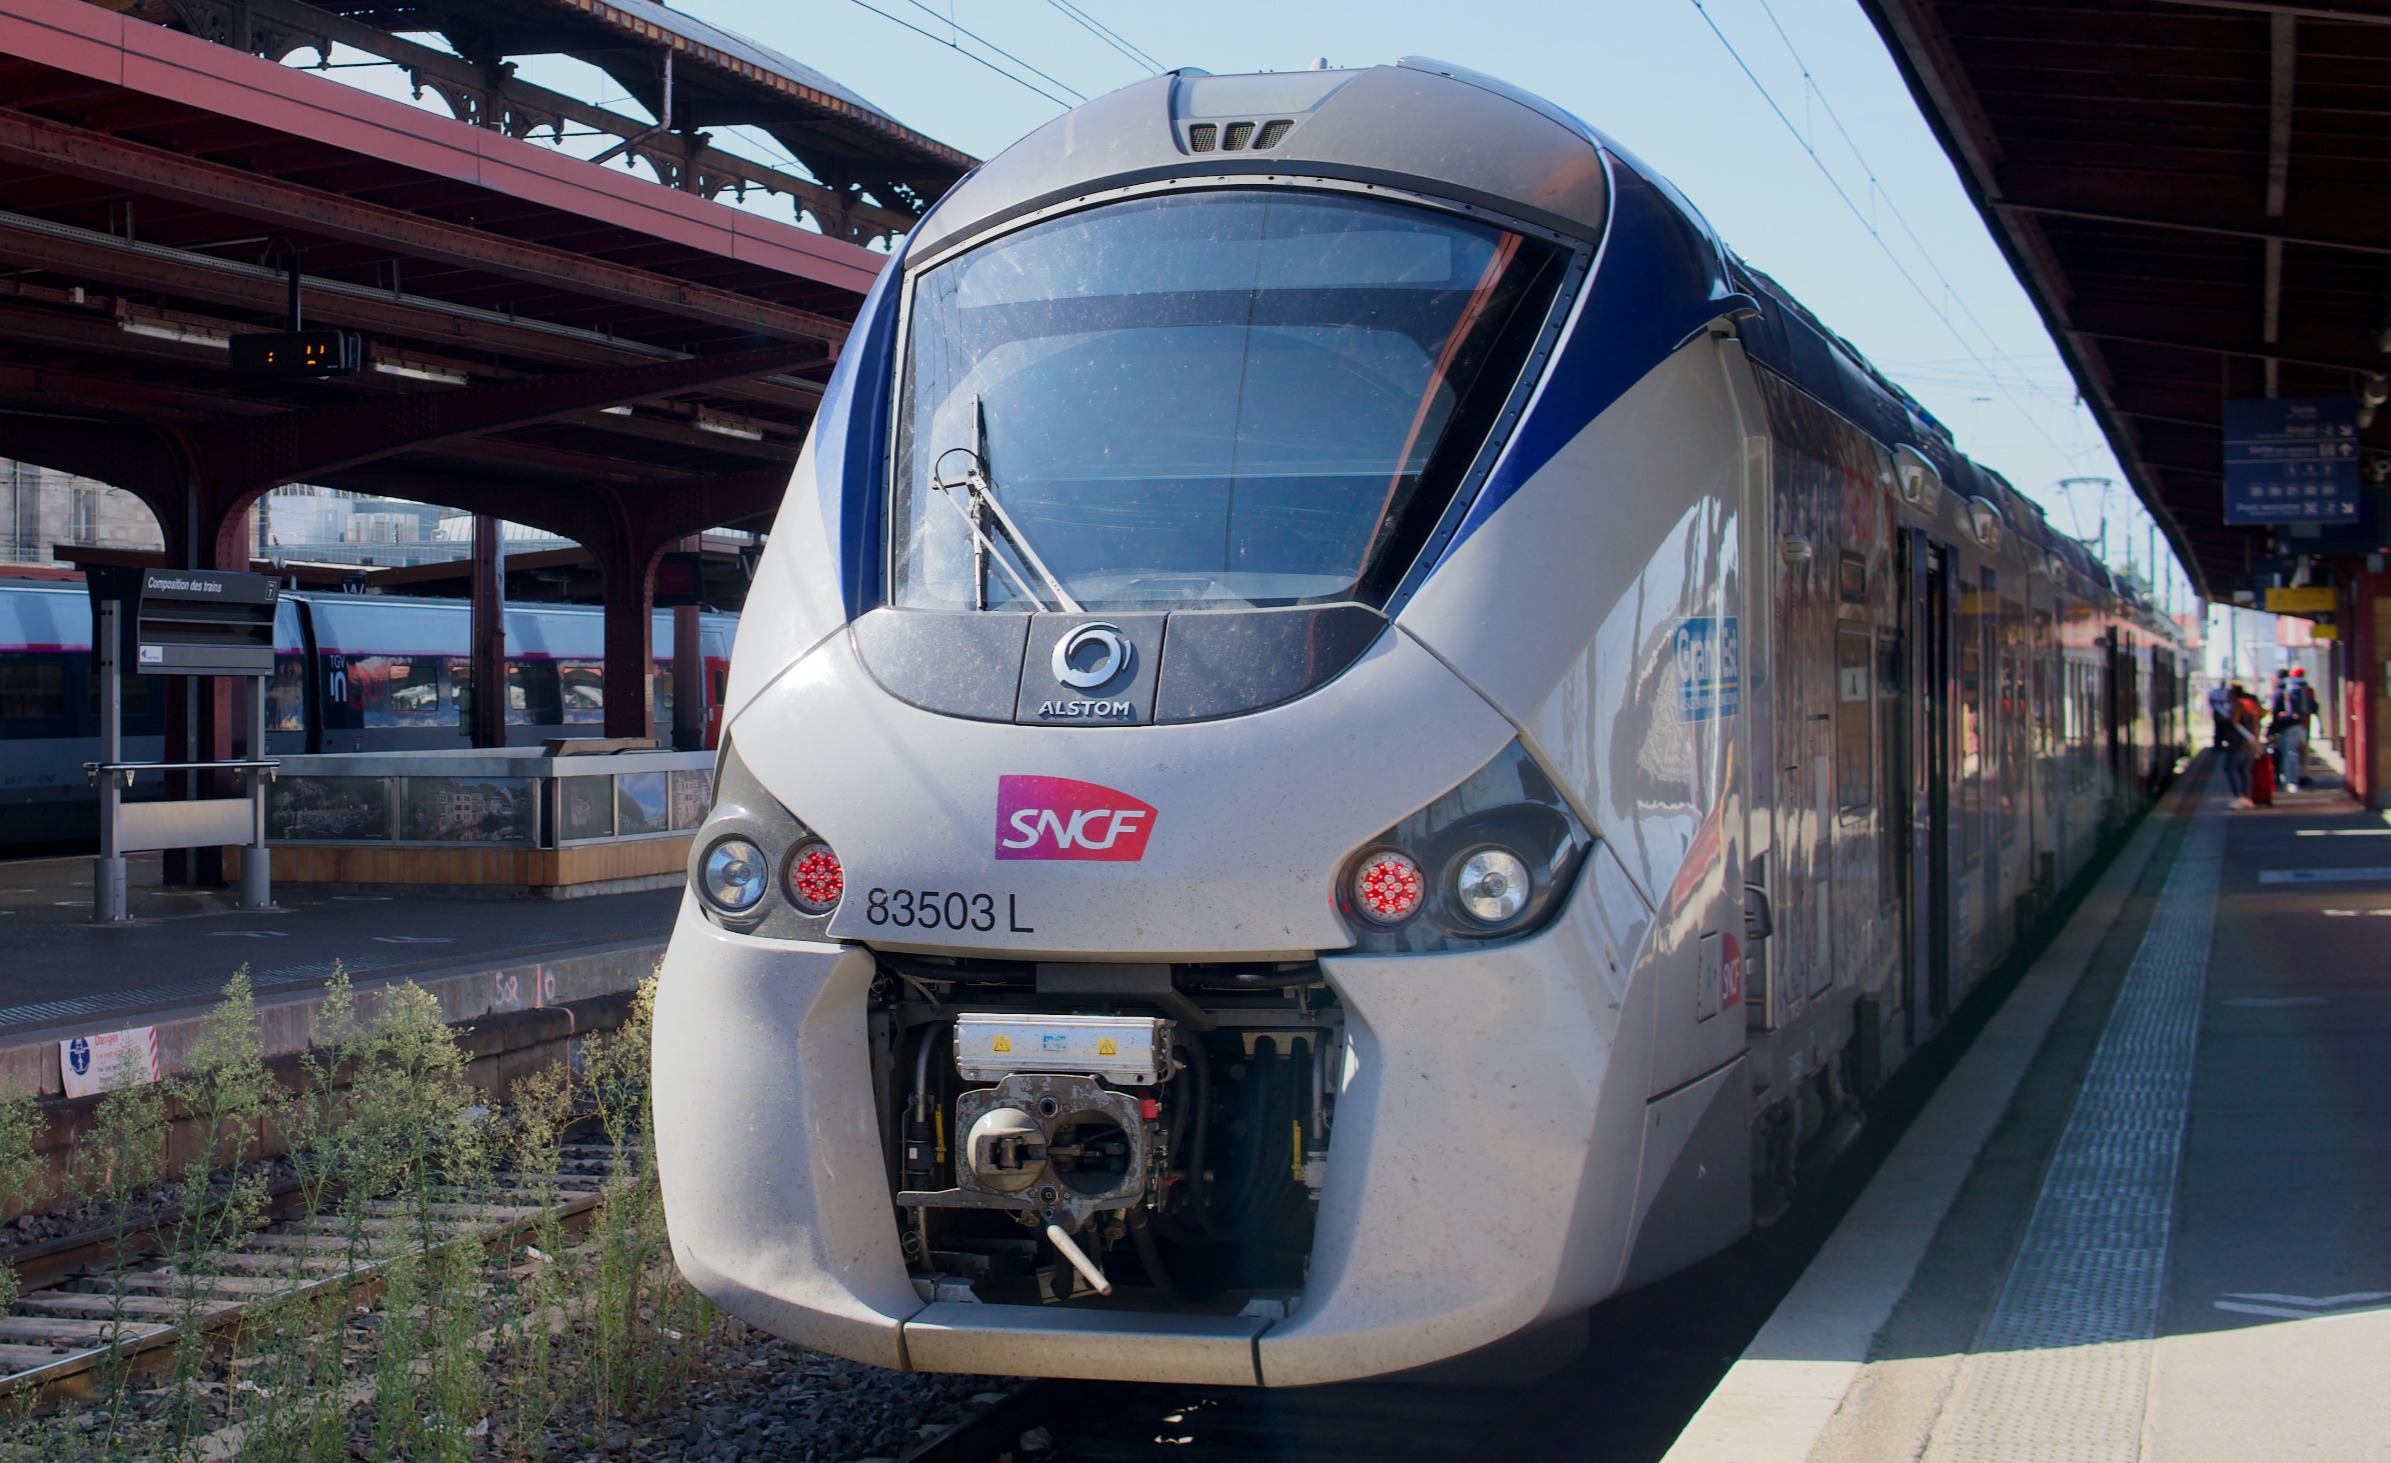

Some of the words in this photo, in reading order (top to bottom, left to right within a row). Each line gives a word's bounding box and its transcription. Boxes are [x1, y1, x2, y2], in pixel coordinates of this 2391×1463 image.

[148, 577, 189, 591] Composition
[190, 580, 202, 591] des
[203, 581, 222, 592] trains
[329, 655, 346, 669] TGV
[1038, 700, 1131, 717] ALSTOM
[1001, 808, 1147, 850] SNCF
[866, 887, 996, 932] 83503
[1009, 893, 1034, 933] L
[95, 1033, 119, 1046] Danger
